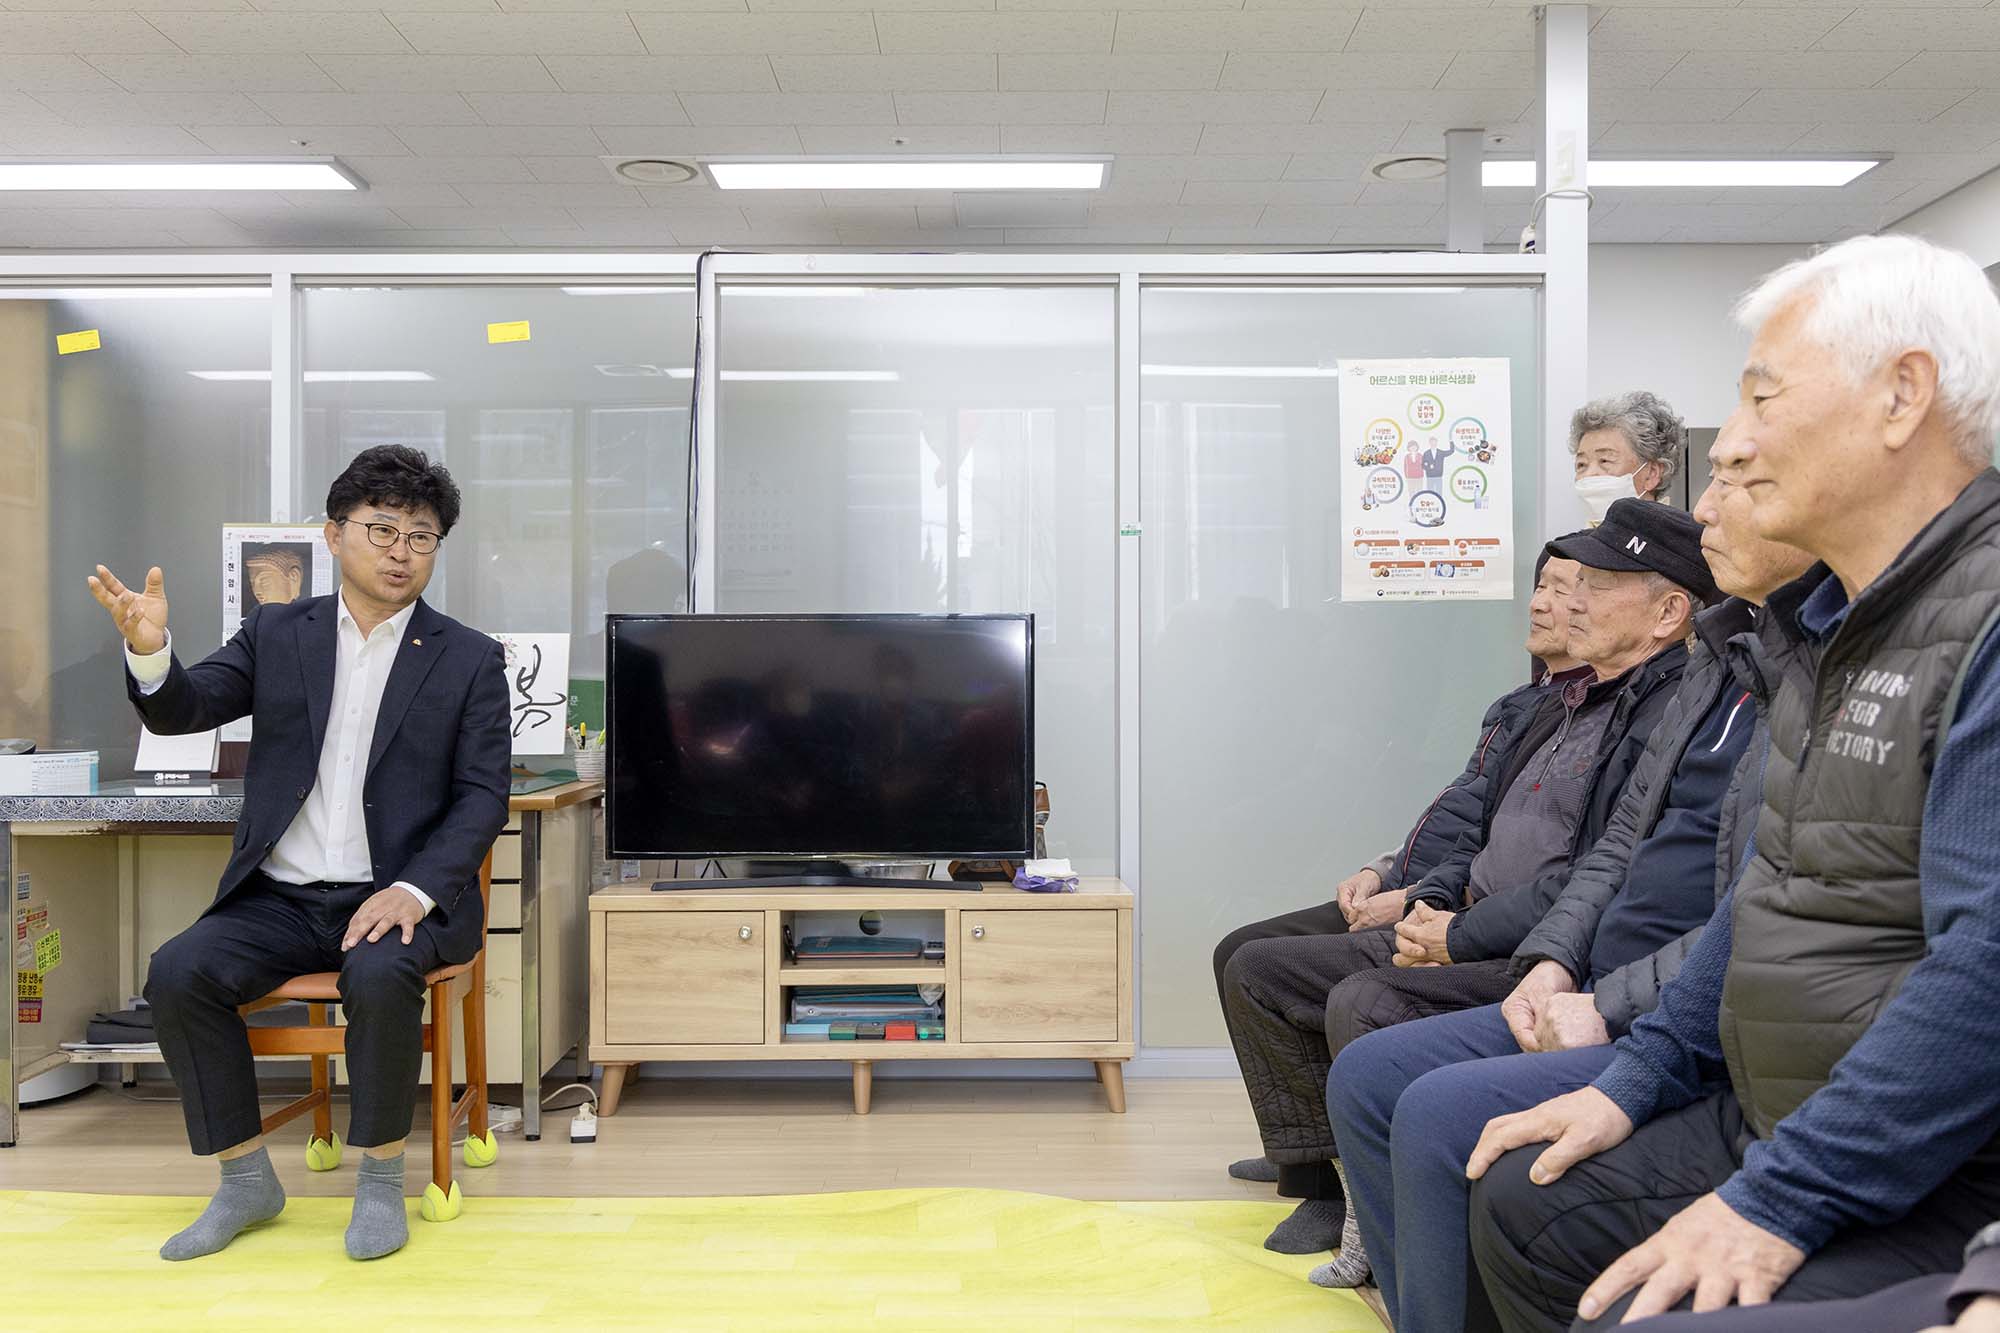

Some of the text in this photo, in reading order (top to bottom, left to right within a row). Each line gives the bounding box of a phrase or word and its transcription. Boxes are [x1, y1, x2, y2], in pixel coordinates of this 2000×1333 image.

[1369, 374, 1476, 386] 어르신을 위한 바른식생활
[1625, 535, 1647, 555] N
